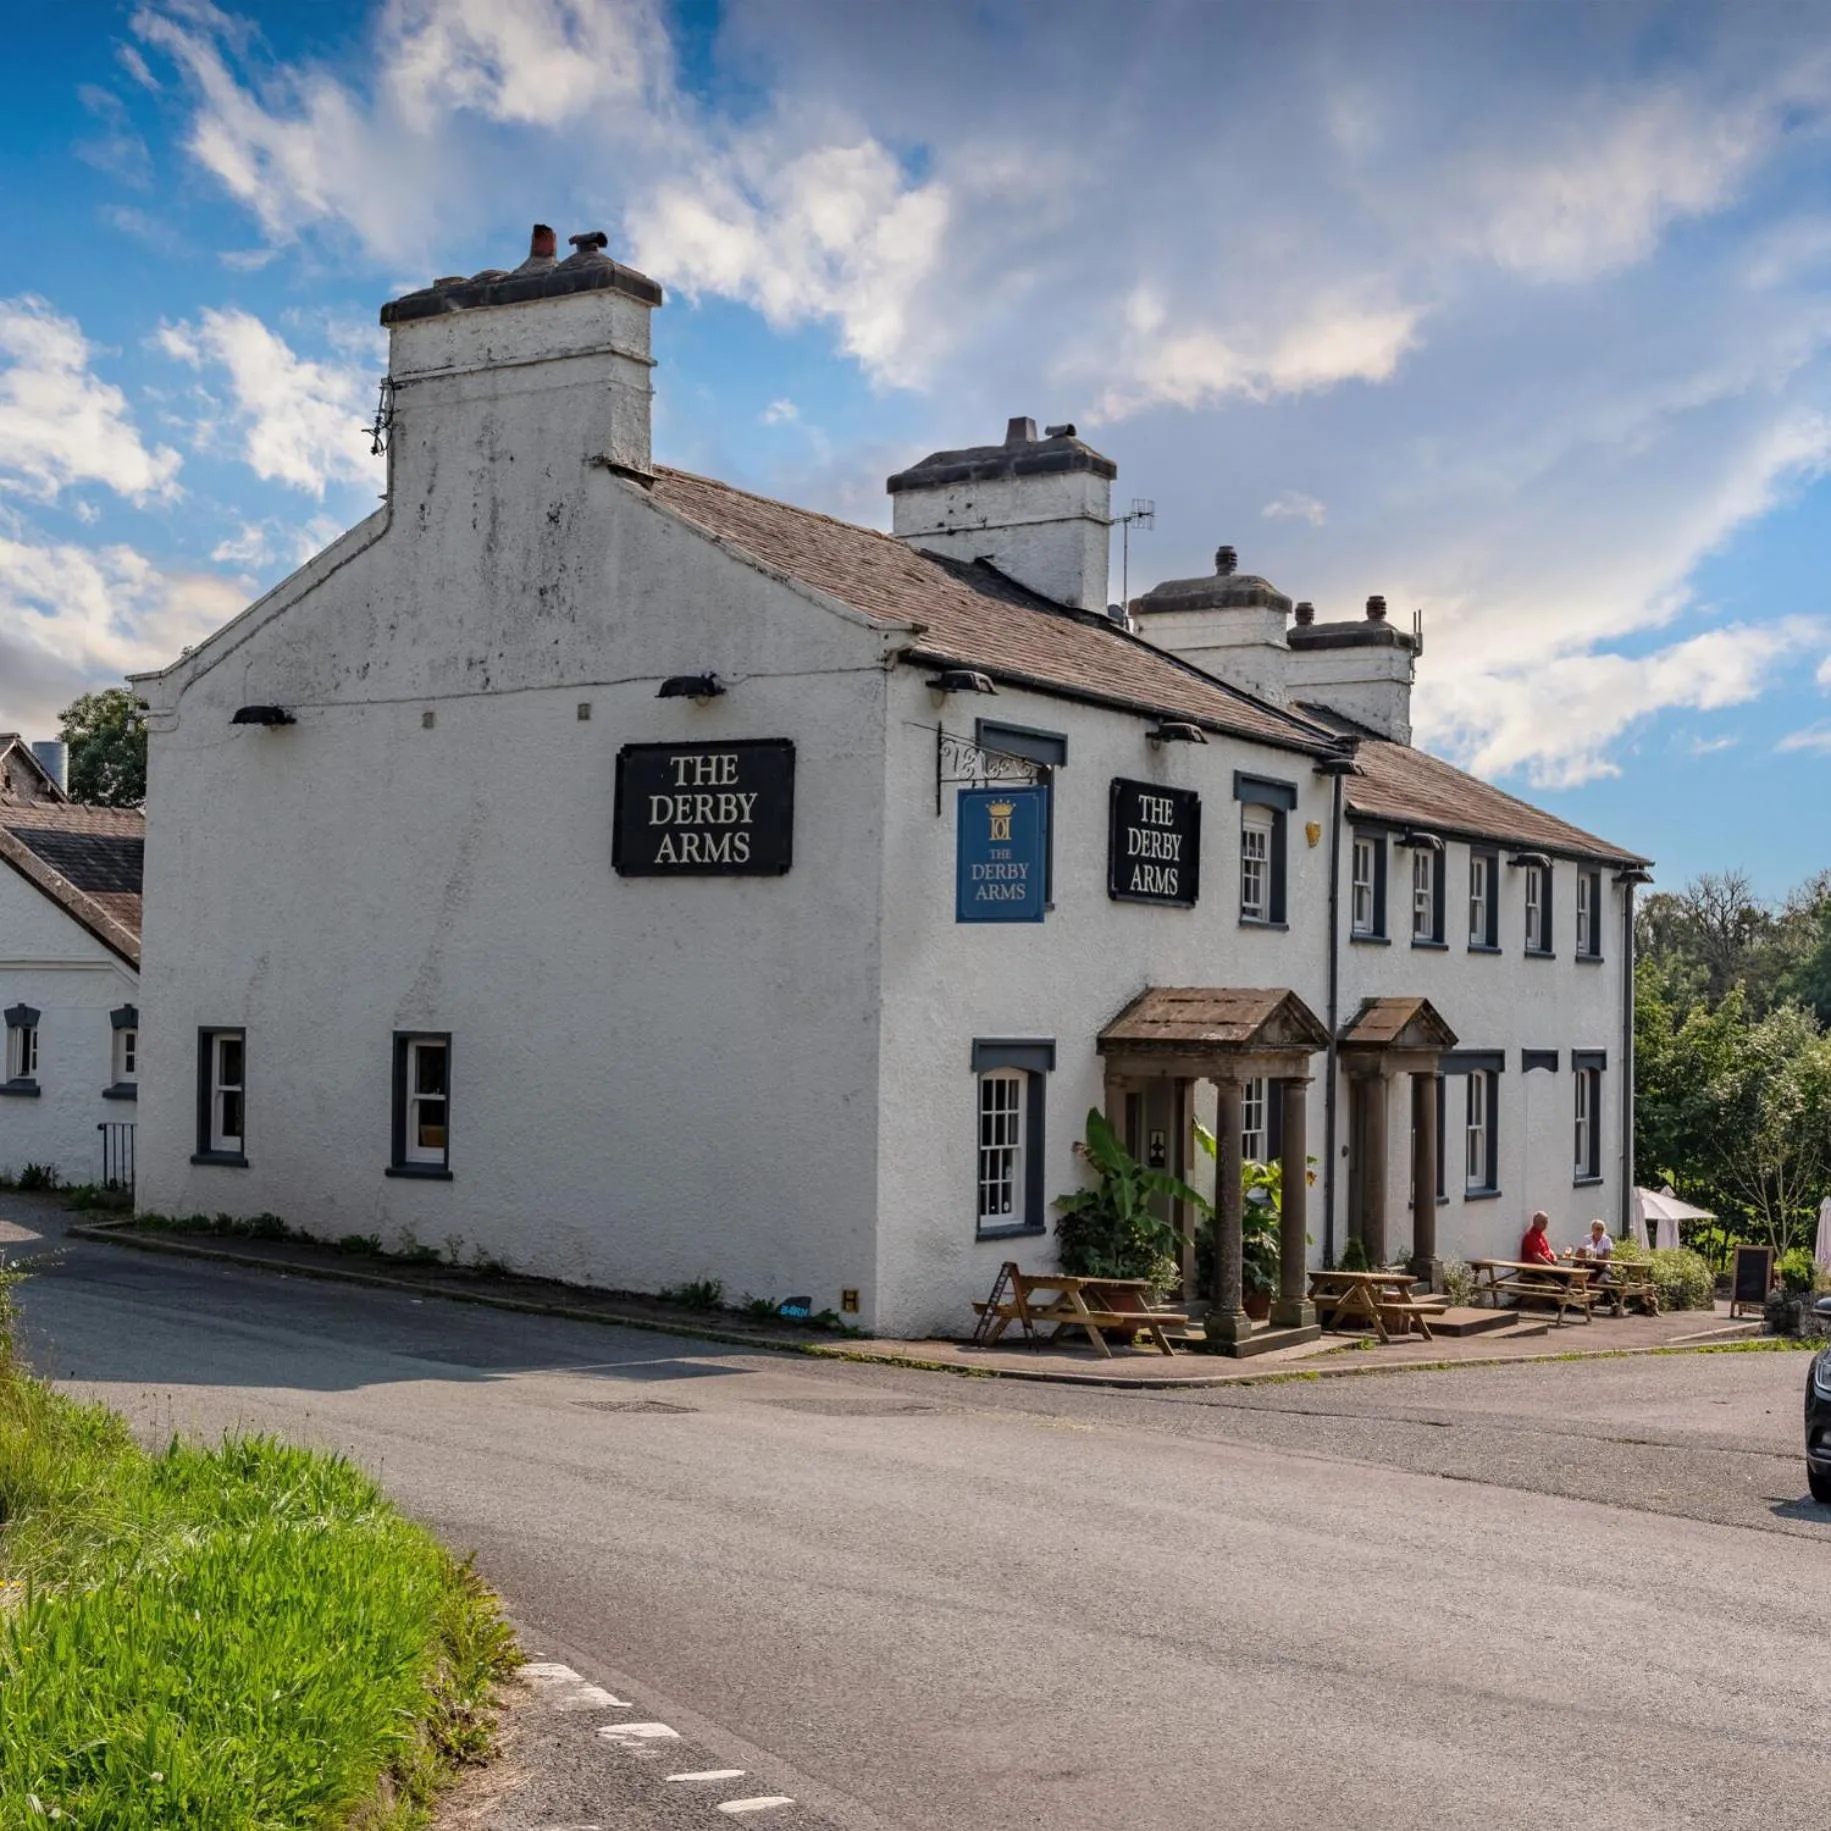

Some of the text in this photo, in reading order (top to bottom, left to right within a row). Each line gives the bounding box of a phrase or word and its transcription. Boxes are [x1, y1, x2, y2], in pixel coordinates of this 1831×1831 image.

[671, 754, 738, 786] THE
[649, 793, 758, 825] DERBY
[1138, 795, 1174, 826] THE
[654, 832, 750, 864] ARMS
[989, 848, 1012, 860] THE
[1127, 827, 1182, 861] DERBY
[971, 862, 1029, 880] DERBY
[1129, 864, 1178, 896] ARMS
[975, 883, 1026, 900] ARMS
